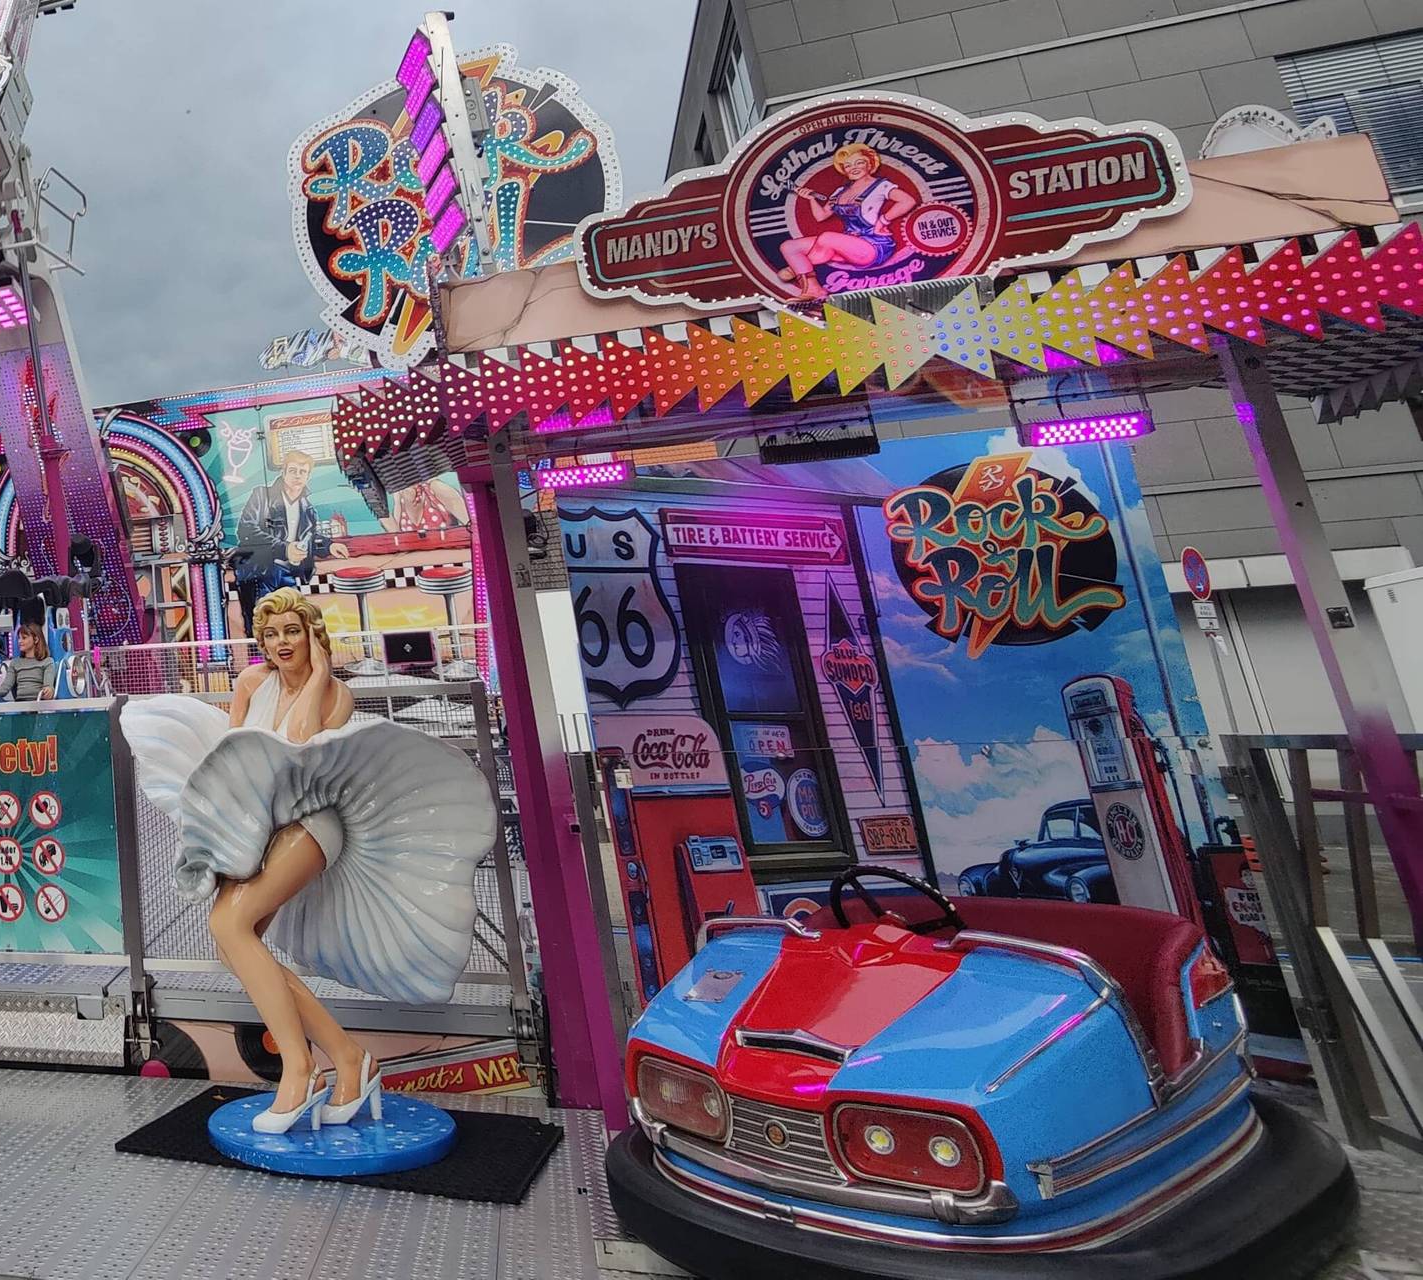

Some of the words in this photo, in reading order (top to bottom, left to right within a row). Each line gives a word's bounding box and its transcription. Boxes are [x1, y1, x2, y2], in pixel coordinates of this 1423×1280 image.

[760, 134, 837, 200] Lethal
[843, 128, 949, 175] Threat
[1008, 152, 1146, 199] STATION
[918, 221, 928, 231] IN
[929, 220, 936, 230] &
[937, 217, 955, 228] OUT
[920, 226, 958, 241] SERVICE
[607, 222, 718, 265] MANDY'S
[825, 258, 925, 292] Garage
[886, 474, 1108, 562] Rock
[673, 527, 706, 544] TIRE
[710, 529, 719, 545] &
[722, 527, 779, 547] BATTERY
[783, 531, 837, 548] SERVICE
[916, 544, 1125, 633] Roll
[575, 586, 656, 668] 66
[833, 647, 859, 660] BLUE
[826, 660, 874, 683] SUNOCO
[647, 728, 676, 737] DRINK
[748, 740, 786, 752] OPEN
[650, 772, 660, 780] IN
[664, 772, 700, 780] BOTTLES
